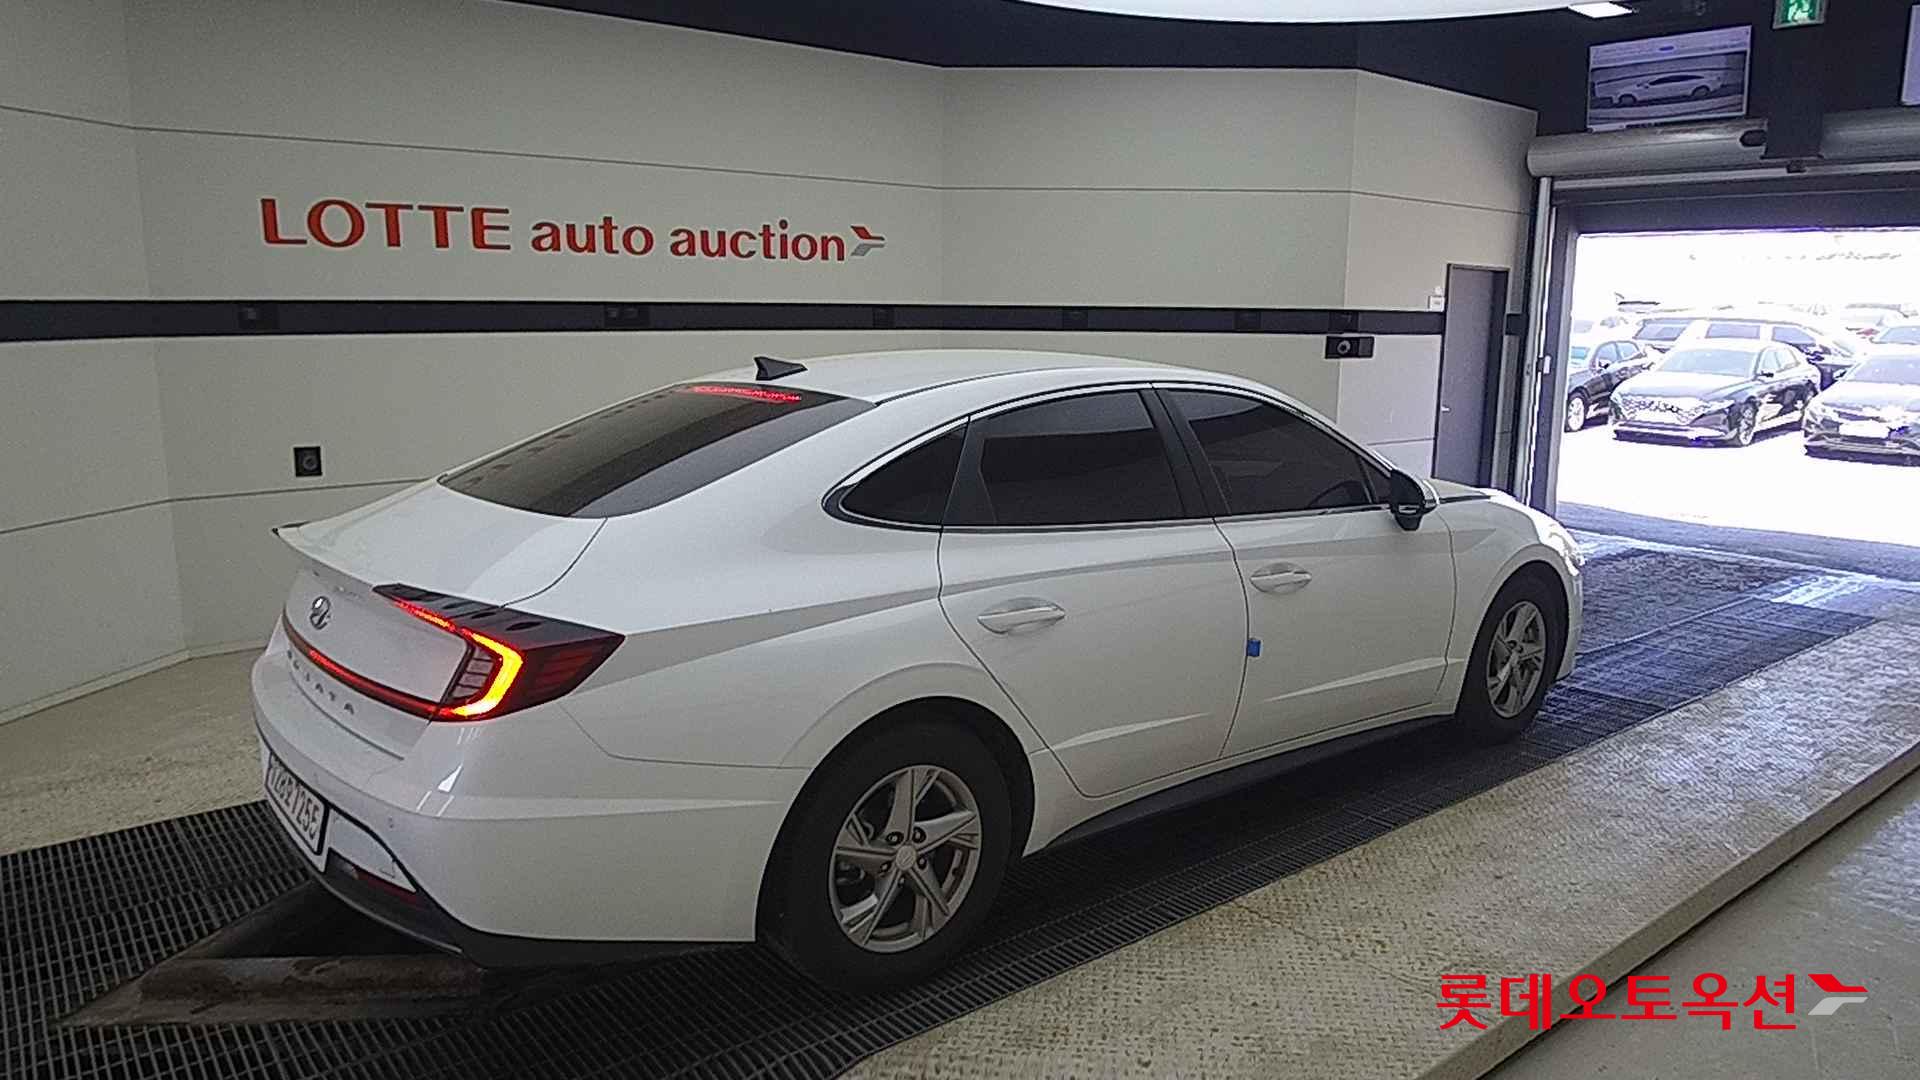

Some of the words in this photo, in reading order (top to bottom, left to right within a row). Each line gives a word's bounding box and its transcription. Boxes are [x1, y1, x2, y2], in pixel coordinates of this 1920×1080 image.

[261, 198, 511, 250] LOTTE
[531, 217, 654, 255] auto
[669, 220, 846, 261] auction
